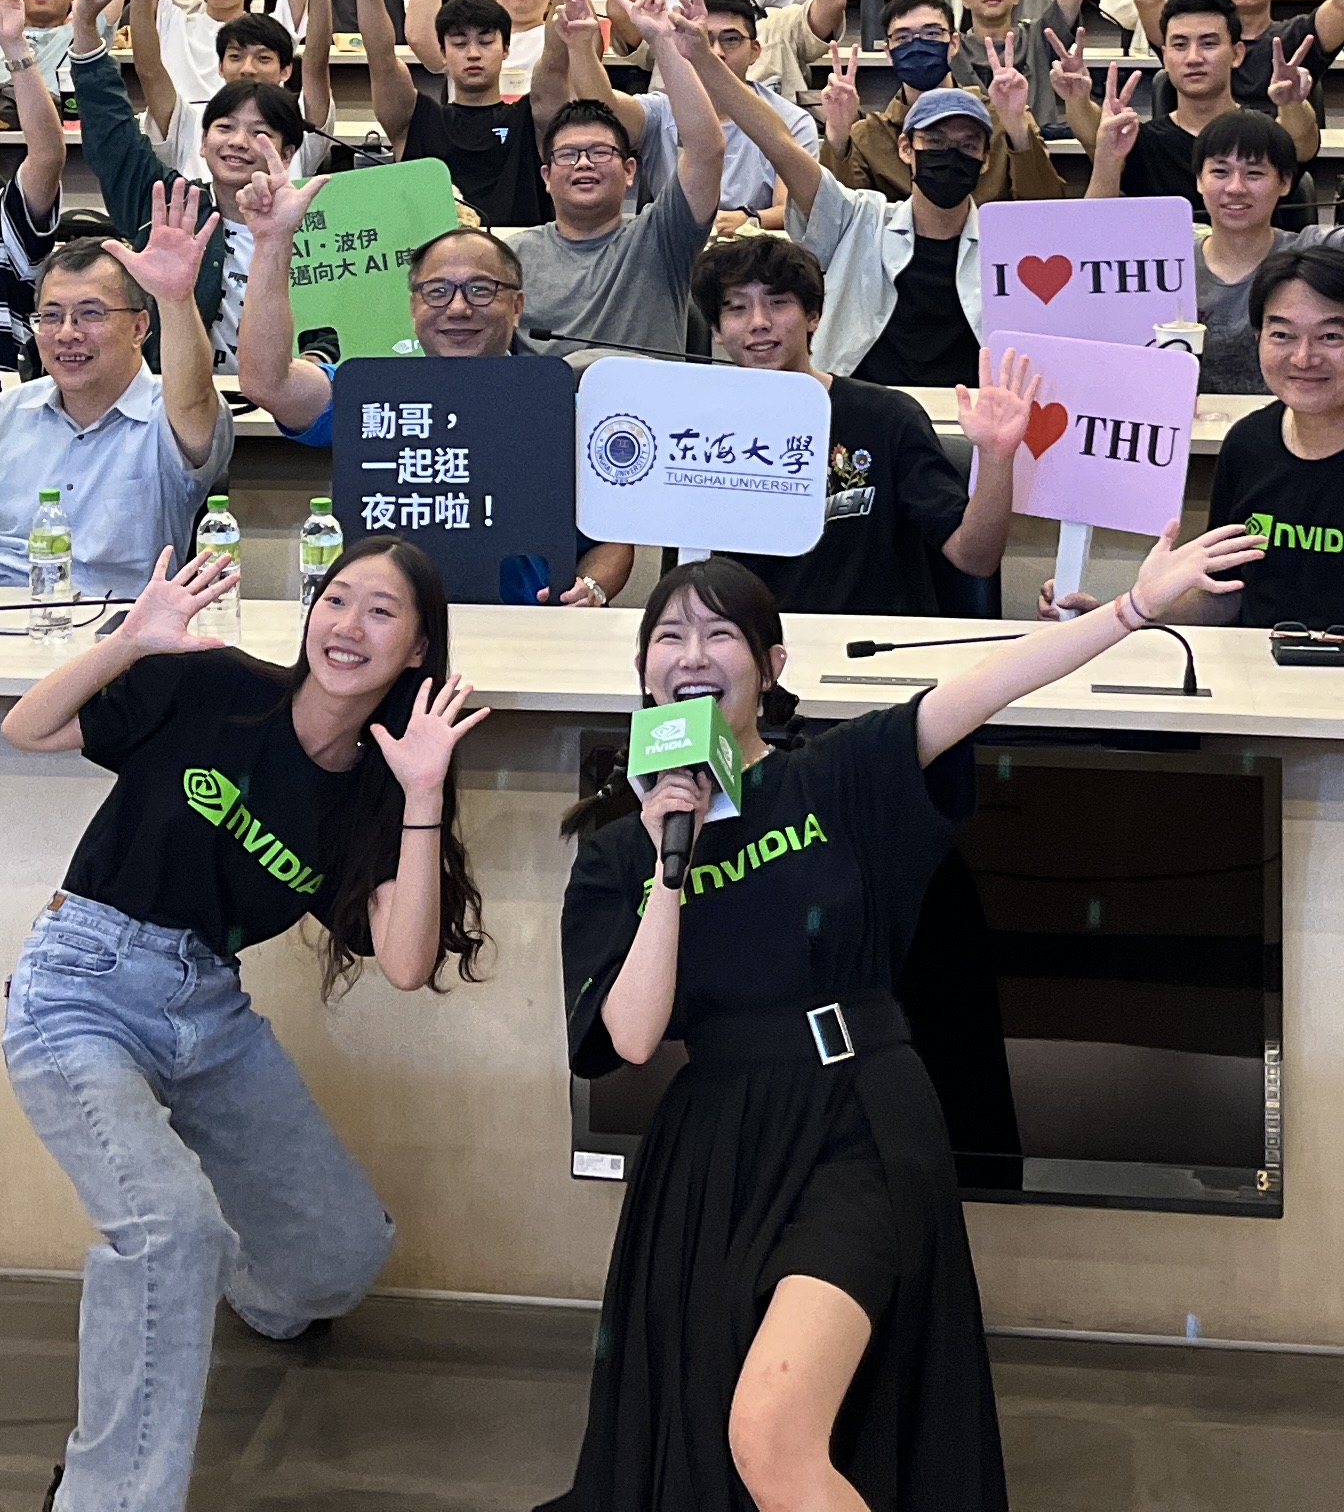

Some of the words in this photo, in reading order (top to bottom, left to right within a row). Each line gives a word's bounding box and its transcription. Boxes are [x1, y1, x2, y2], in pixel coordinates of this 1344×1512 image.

[992, 262, 1010, 298] I
[1079, 258, 1186, 295] THU
[1075, 414, 1181, 468] THU
[361, 447, 471, 485] 一起逛
[665, 470, 727, 487] TUNGHAI
[728, 475, 812, 494] UNIVERSITY
